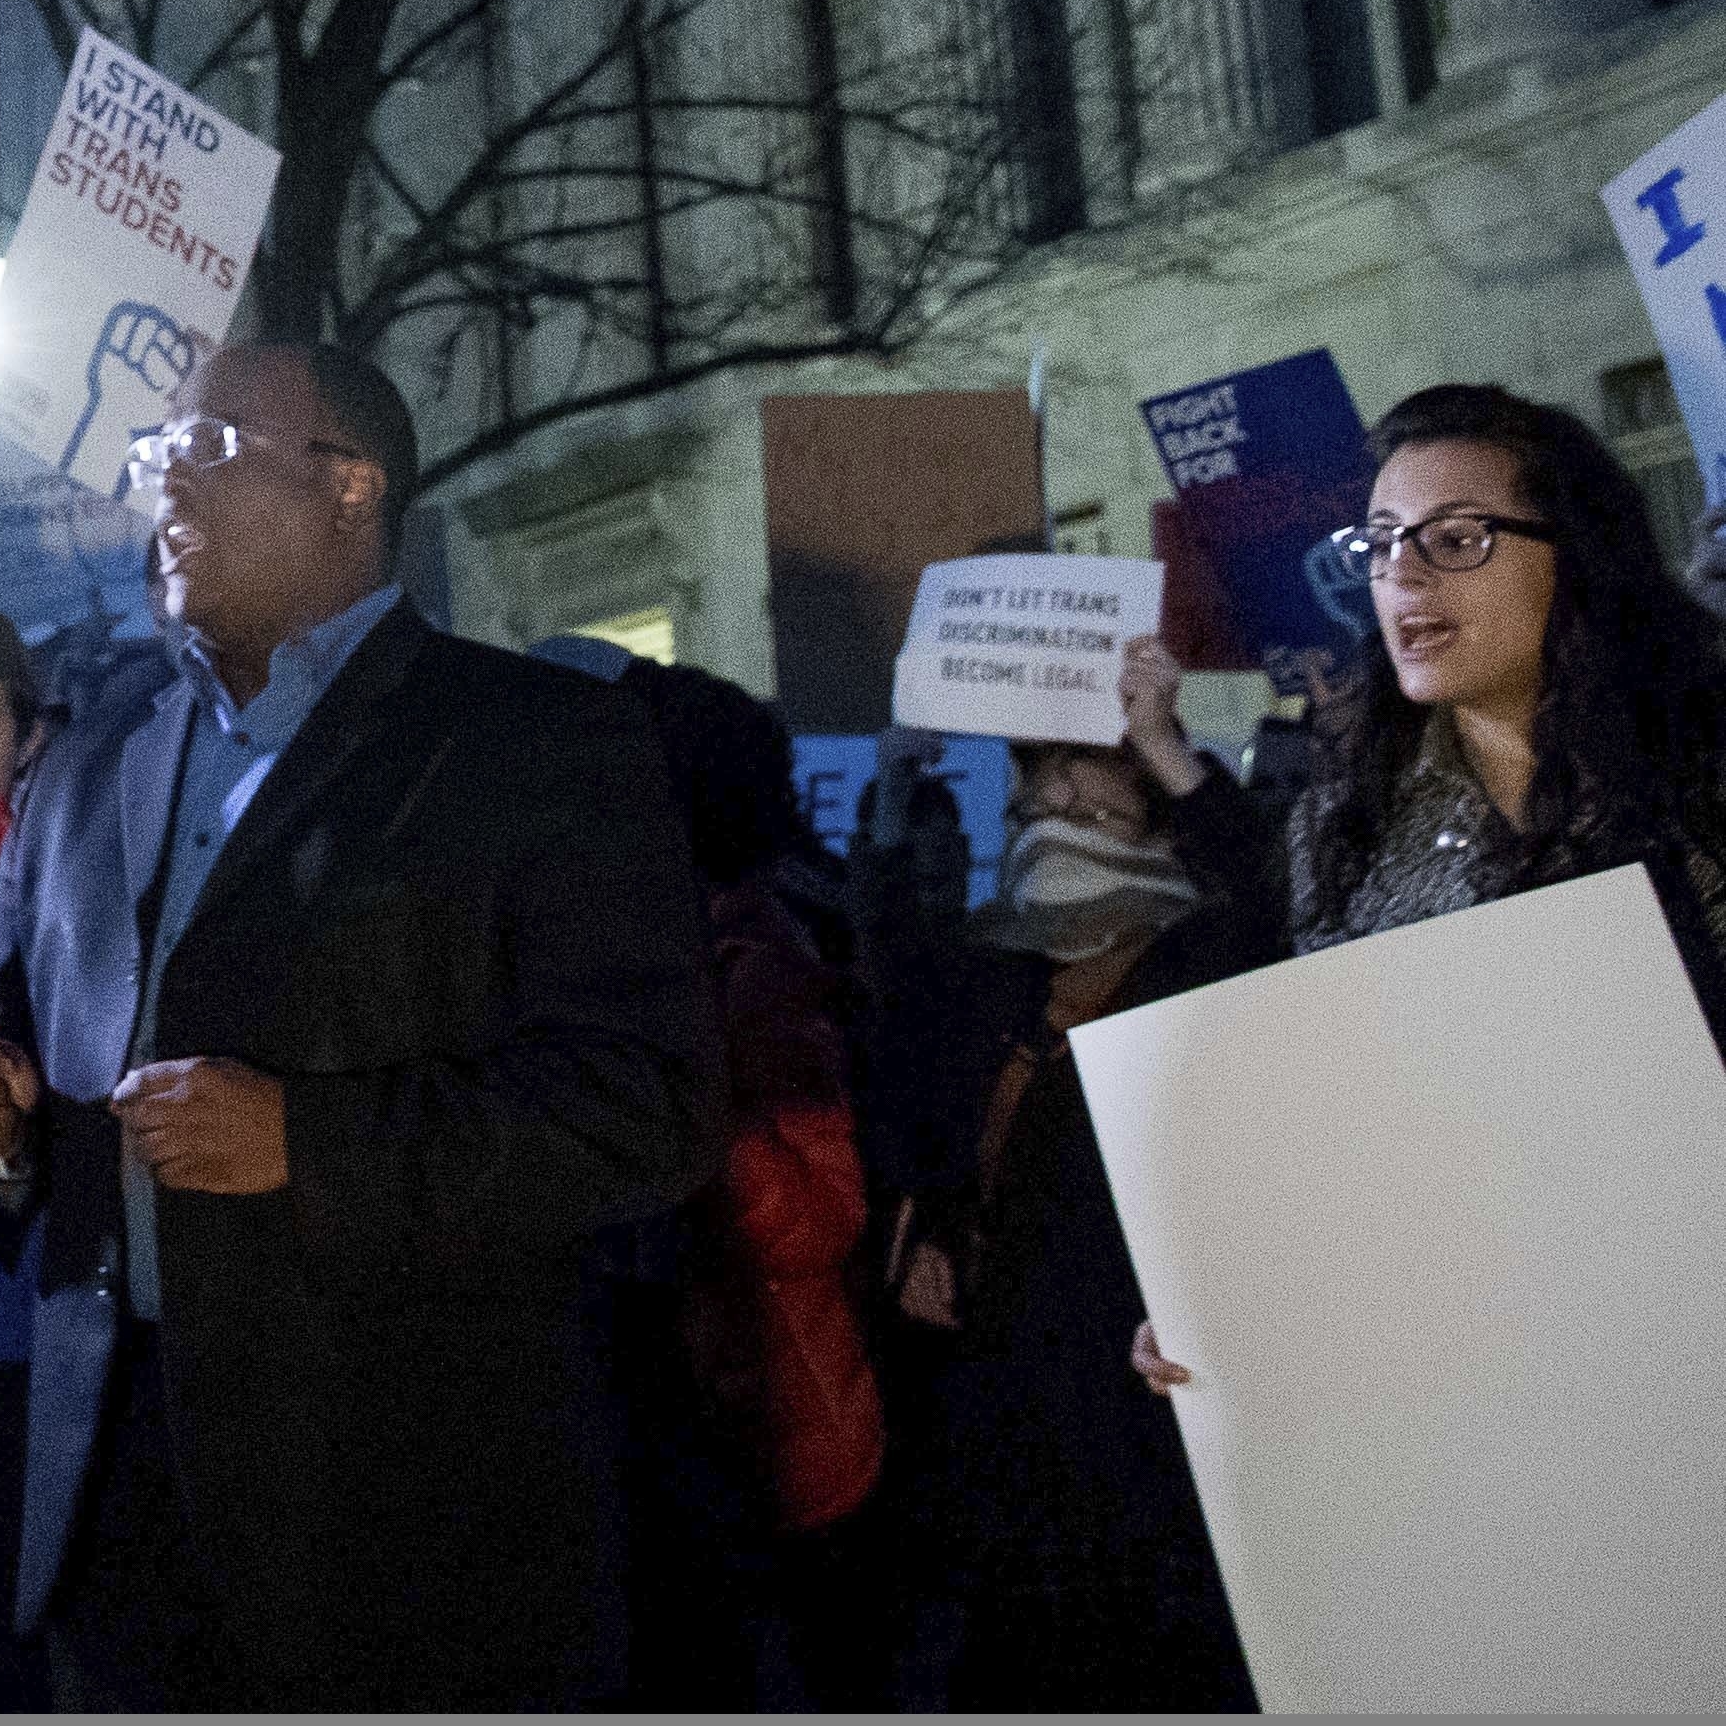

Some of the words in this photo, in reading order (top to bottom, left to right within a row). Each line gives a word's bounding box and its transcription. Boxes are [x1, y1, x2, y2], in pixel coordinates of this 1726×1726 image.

[74, 79, 169, 162] WITH
[83, 43, 99, 76] I
[103, 59, 222, 155] STAND
[67, 114, 184, 214] TRANS
[48, 151, 239, 293] STUDENTS
[1149, 383, 1237, 430] FIGHT
[1161, 415, 1251, 459] BACK
[1174, 449, 1241, 487] FOR
[1007, 587, 1044, 610] LET
[1049, 588, 1121, 617] TRANS
[938, 619, 1114, 654] DISCRIMINATION
